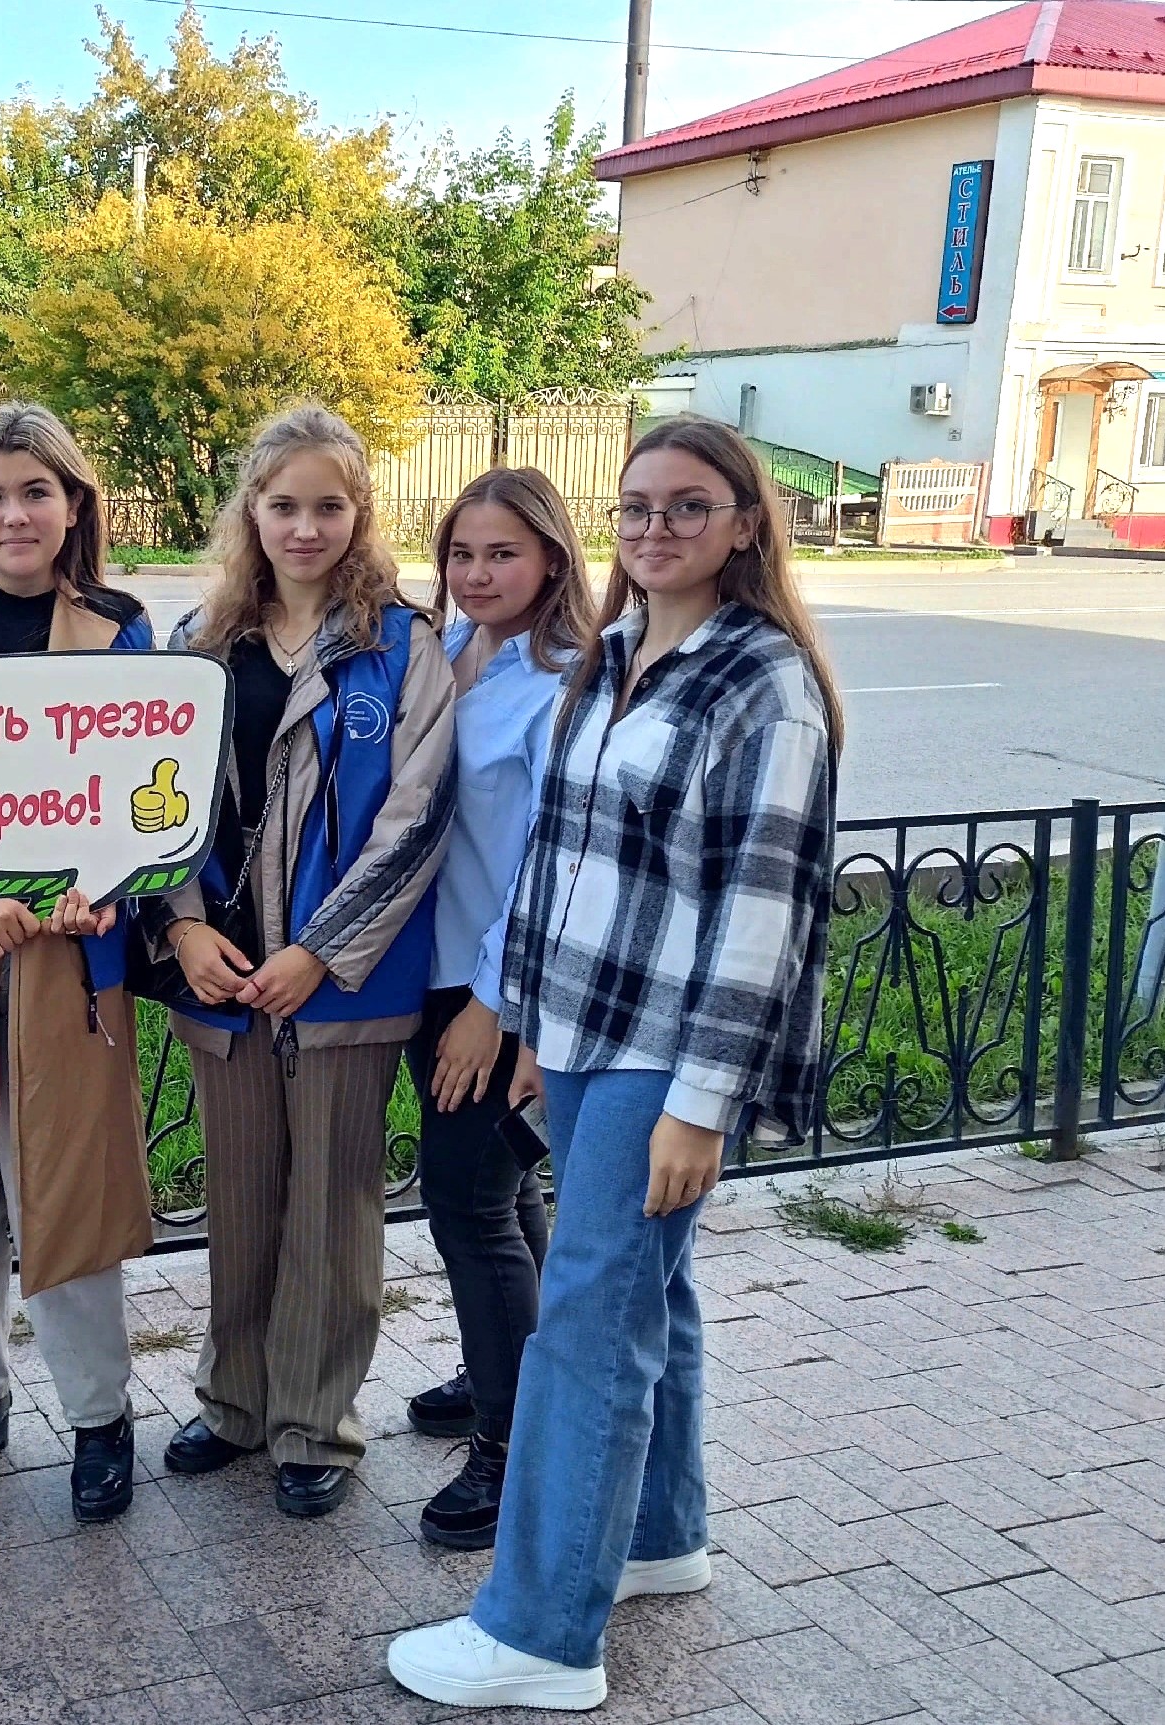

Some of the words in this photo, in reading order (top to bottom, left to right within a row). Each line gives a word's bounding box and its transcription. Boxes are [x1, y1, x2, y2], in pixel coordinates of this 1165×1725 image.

[953, 164, 982, 176] АТЕЛЬЕ
[949, 178, 974, 295] СТИЛЬ
[44, 699, 196, 754] трезво
